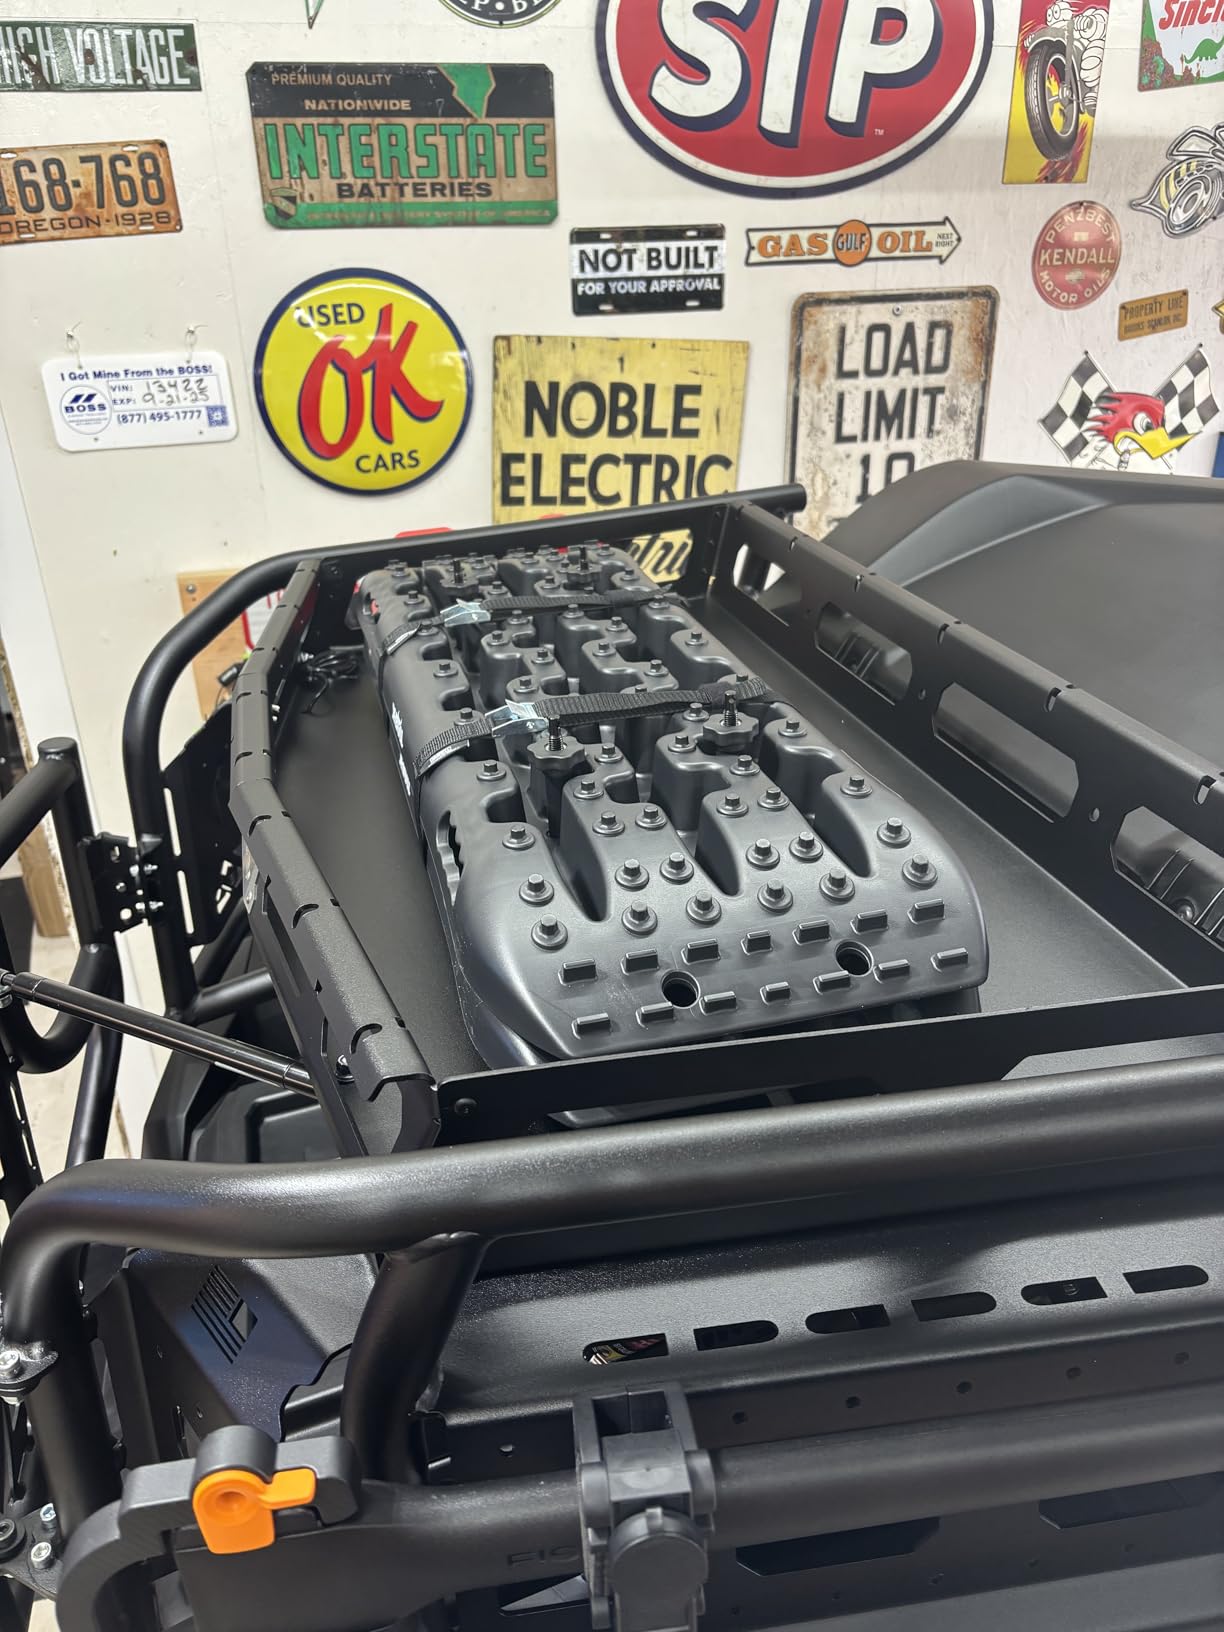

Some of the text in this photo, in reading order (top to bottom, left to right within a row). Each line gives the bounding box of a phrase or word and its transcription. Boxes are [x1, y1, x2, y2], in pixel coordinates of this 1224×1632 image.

[1158, 0, 1224, 30] Sincl
[63, 28, 191, 85] VOLTAGE
[271, 73, 392, 86] PREMIUM QUALITY
[304, 99, 412, 111] NATIONWIDE
[263, 123, 547, 180] INTERSTATE
[336, 182, 493, 199] BATTERIES
[1046, 206, 1117, 244] PENZBEST
[756, 231, 933, 258] GAS GULF OIL
[1039, 248, 1115, 266] KENDALL
[578, 245, 719, 273] NOT BUILT
[577, 277, 721, 296] FOR YOUR APPROVAL
[1039, 267, 1111, 303] MOTOR OILS
[295, 302, 365, 328] USED
[836, 320, 953, 380] LOAD
[60, 365, 212, 381] I Got Mine From the BOSS!
[297, 303, 446, 461] OK
[110, 385, 133, 393] VIN:
[64, 403, 107, 413] BOSS
[117, 412, 147, 425] (877)
[149, 410, 202, 422] 495-1777
[524, 380, 702, 438] NOBLE
[834, 386, 946, 444] LIMIT
[355, 449, 420, 474] CARS
[501, 452, 733, 506] ELECTRIC
